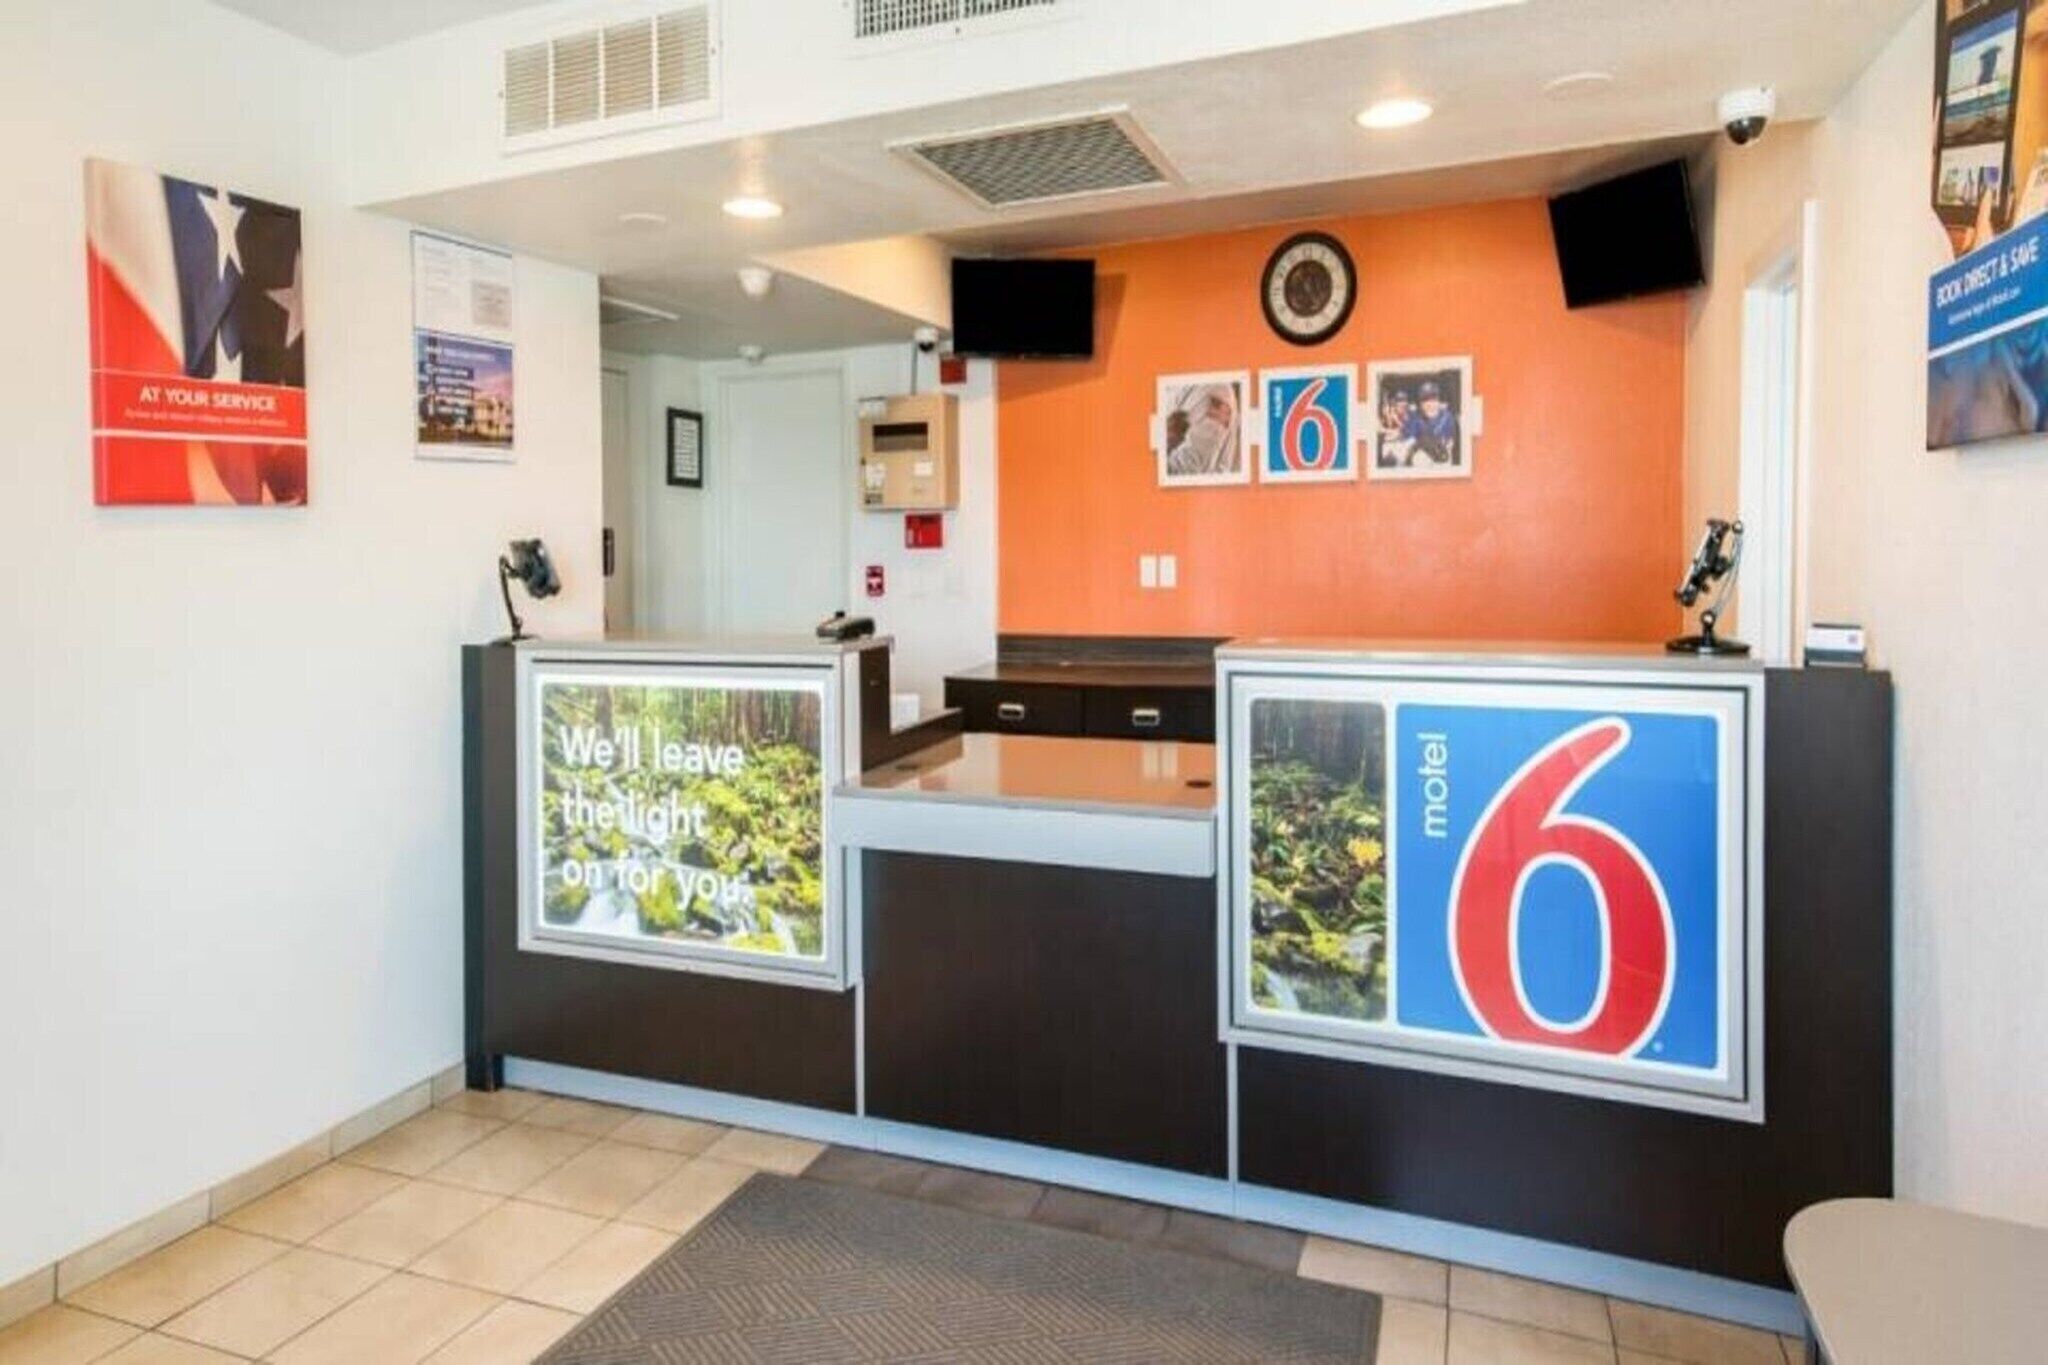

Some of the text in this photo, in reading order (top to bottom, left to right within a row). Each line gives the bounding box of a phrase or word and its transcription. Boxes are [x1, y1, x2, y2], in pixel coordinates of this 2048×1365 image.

[140, 386, 275, 412] AT YOUR SERVICE
[1281, 378, 1339, 471] 6
[560, 724, 744, 774] We'll leave
[561, 785, 706, 846] the light
[1417, 731, 1448, 839] motel
[562, 858, 602, 890] on
[616, 849, 662, 896] for
[1447, 715, 1677, 1060] 6
